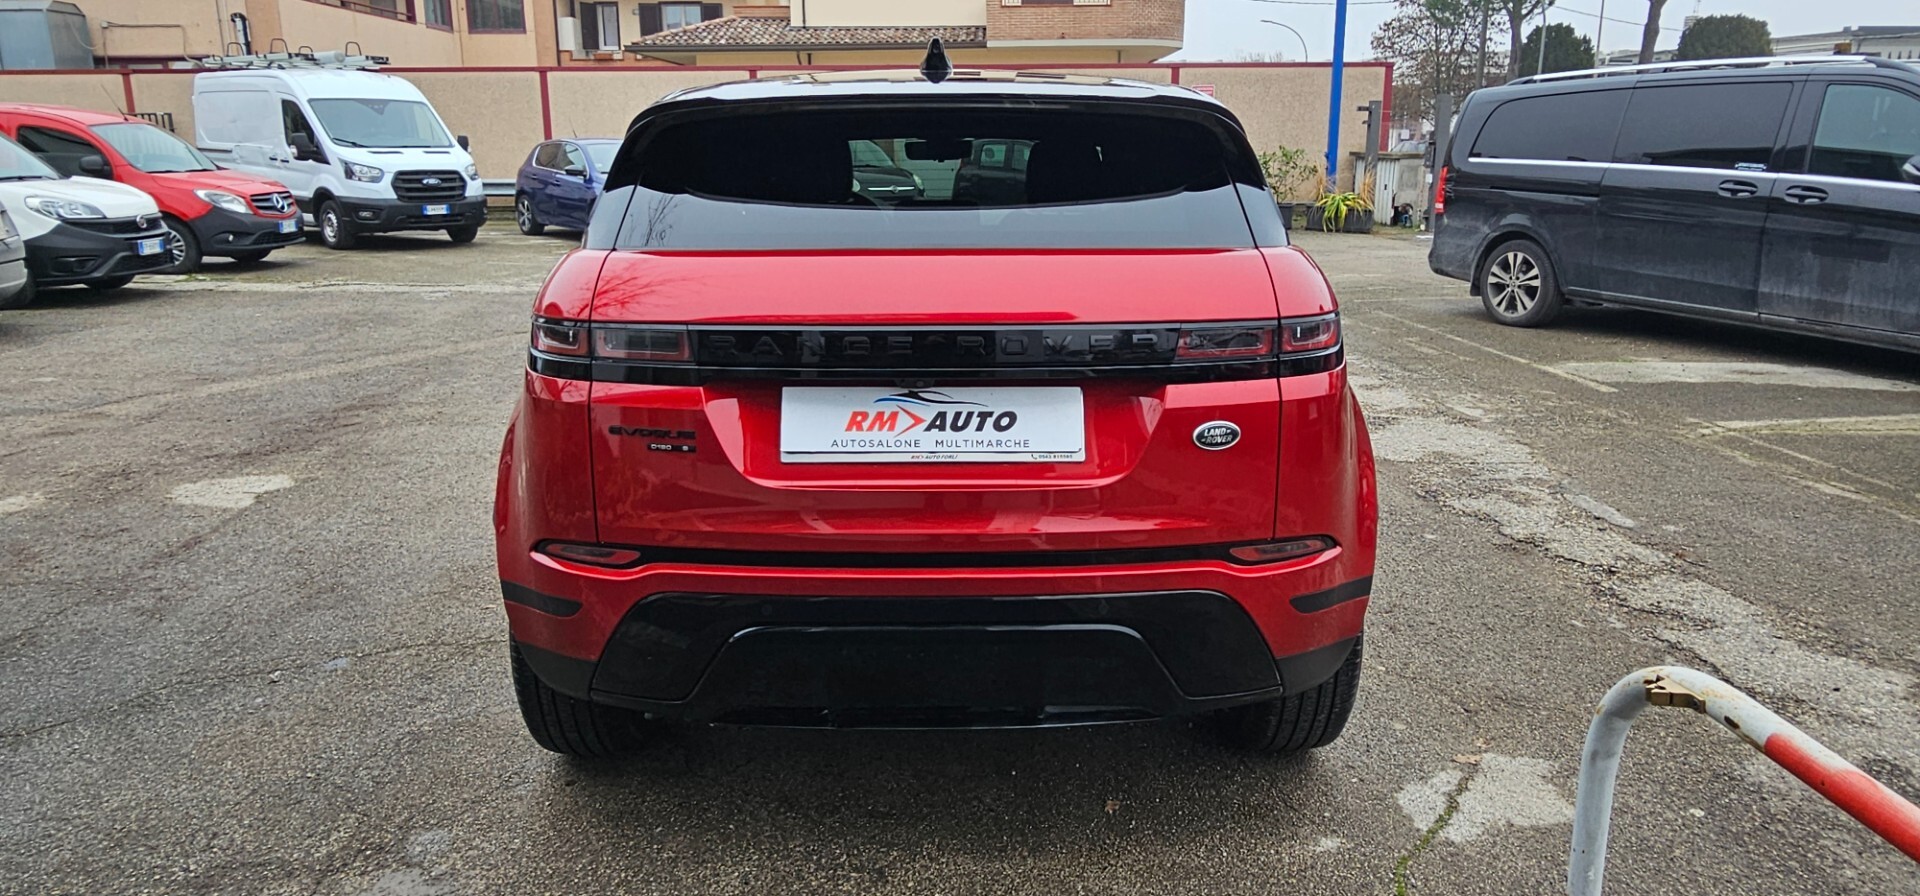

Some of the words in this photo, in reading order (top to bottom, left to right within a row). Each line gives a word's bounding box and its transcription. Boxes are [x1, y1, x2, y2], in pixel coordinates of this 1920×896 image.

[709, 335, 913, 356] RANGE
[957, 334, 1158, 356] ROVER
[923, 410, 1018, 432] AUTO
[608, 425, 696, 439] EVOQUE
[1204, 428, 1226, 437] LAND
[831, 439, 921, 448] AUTOSALONE
[935, 439, 1030, 448] MULTIMARCHE
[1206, 435, 1233, 444] ROVER
